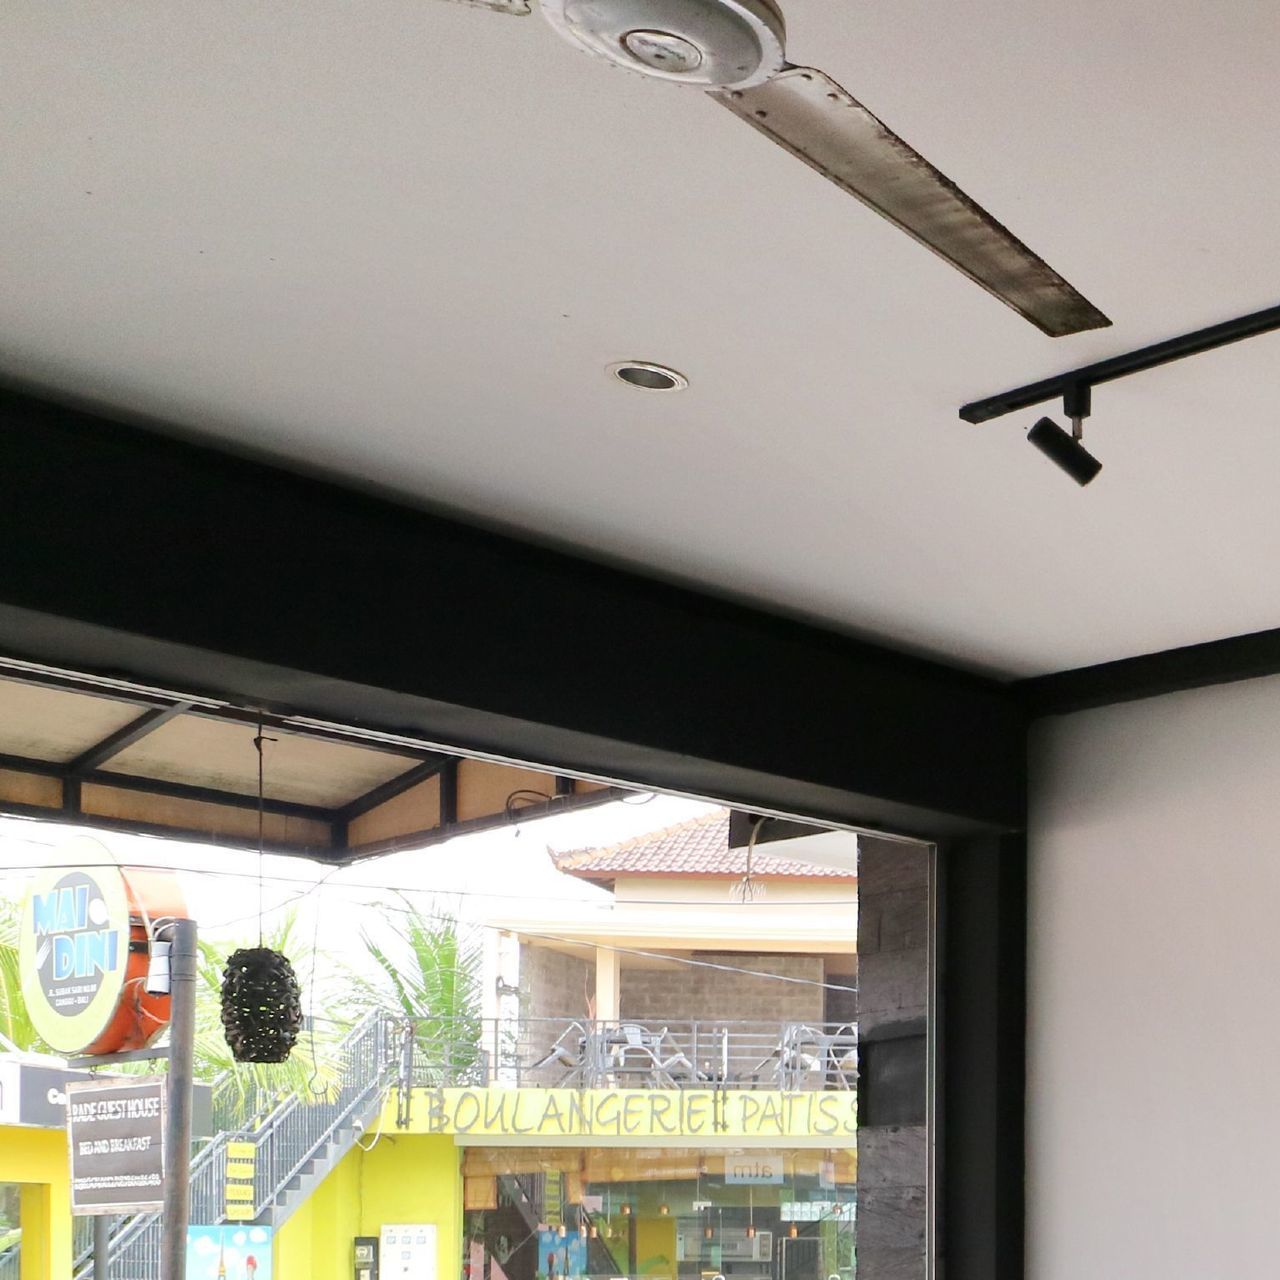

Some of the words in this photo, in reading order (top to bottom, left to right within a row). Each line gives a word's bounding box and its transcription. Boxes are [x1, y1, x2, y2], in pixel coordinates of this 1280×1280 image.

[32, 885, 89, 936] MAI
[53, 928, 118, 981] DINI
[127, 1097, 160, 1119] HOUSE
[93, 1139, 110, 1154] AND
[110, 1136, 152, 1153] BREAKFAST
